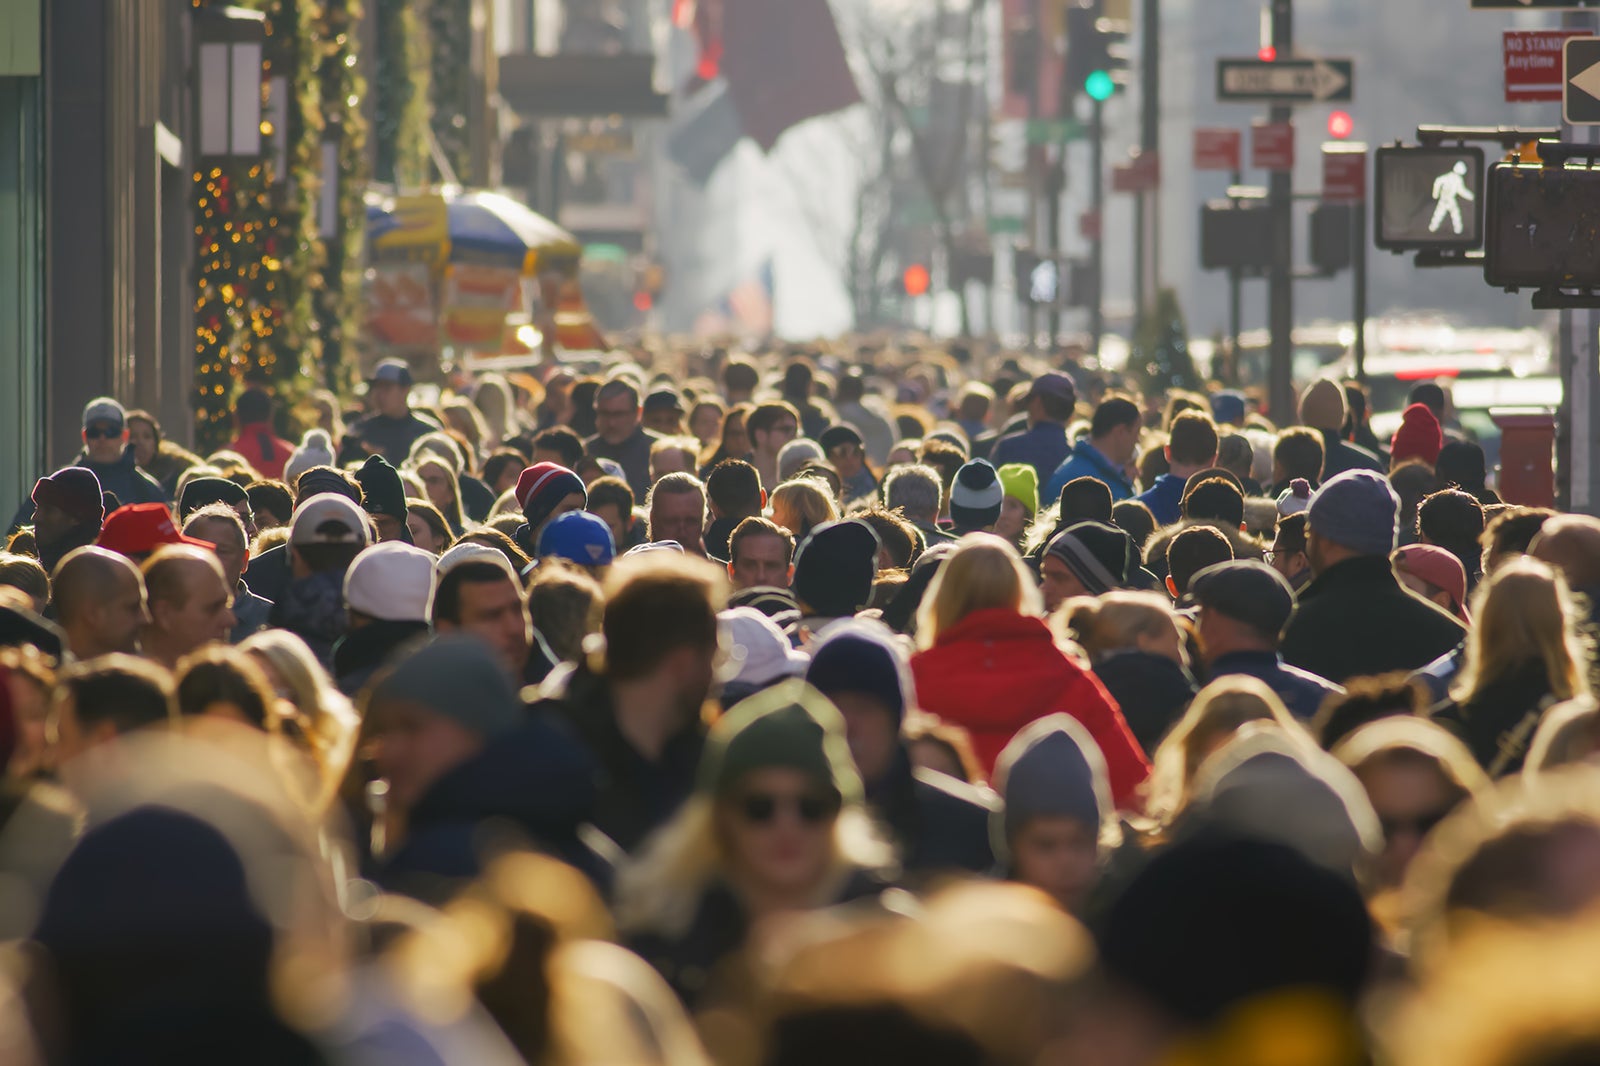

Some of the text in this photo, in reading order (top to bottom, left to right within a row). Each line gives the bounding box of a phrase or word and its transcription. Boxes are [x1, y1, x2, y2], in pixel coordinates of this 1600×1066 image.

[1507, 37, 1563, 51] NO STAND
[1508, 54, 1555, 71] Anytime
